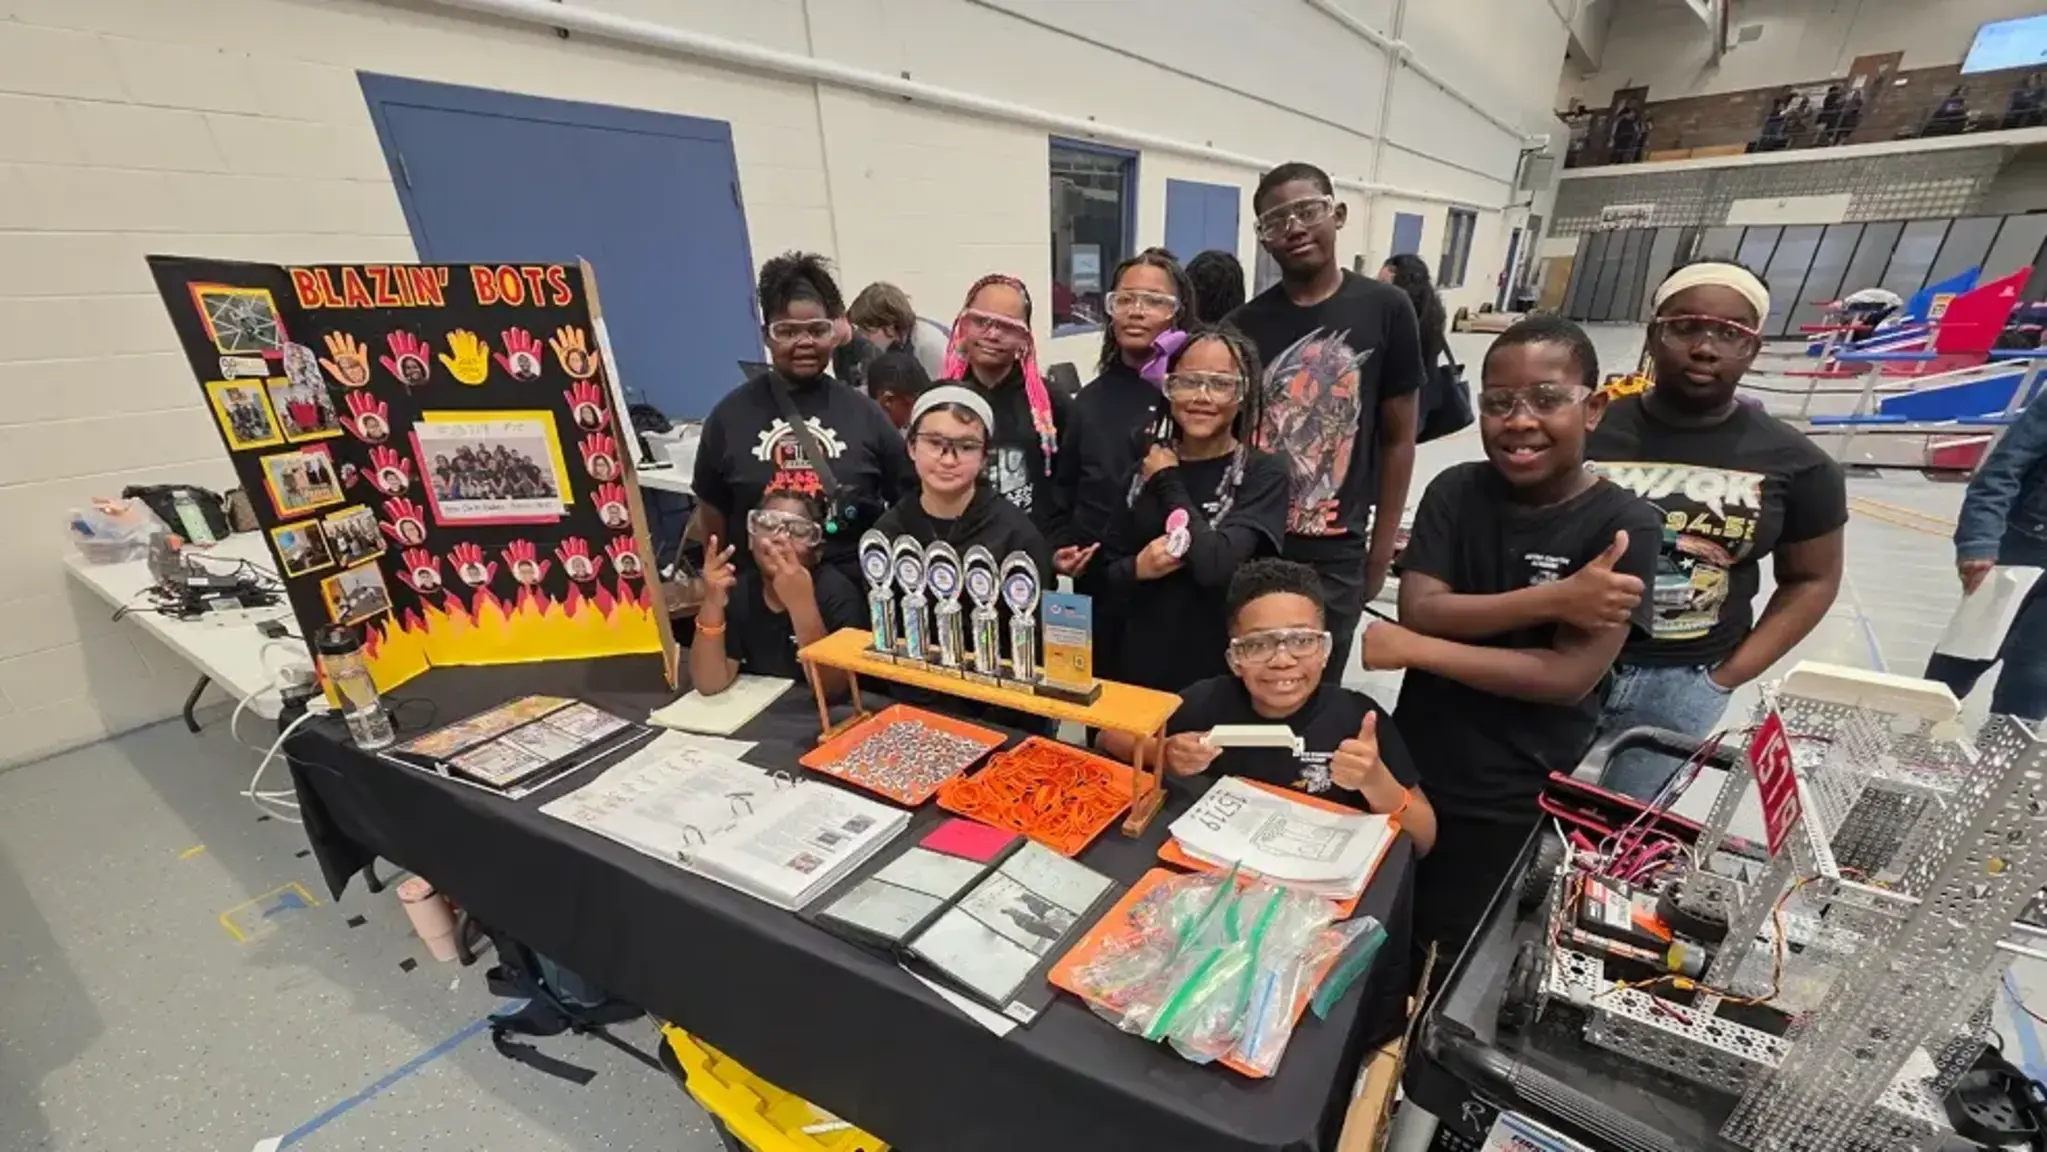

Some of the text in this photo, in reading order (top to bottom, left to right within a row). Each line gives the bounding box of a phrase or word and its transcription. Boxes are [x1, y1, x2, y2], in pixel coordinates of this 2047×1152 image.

[289, 264, 573, 310] BLAZIN' BOTS
[1198, 791, 1249, 832] 15719
[1756, 728, 1798, 850] 15719
